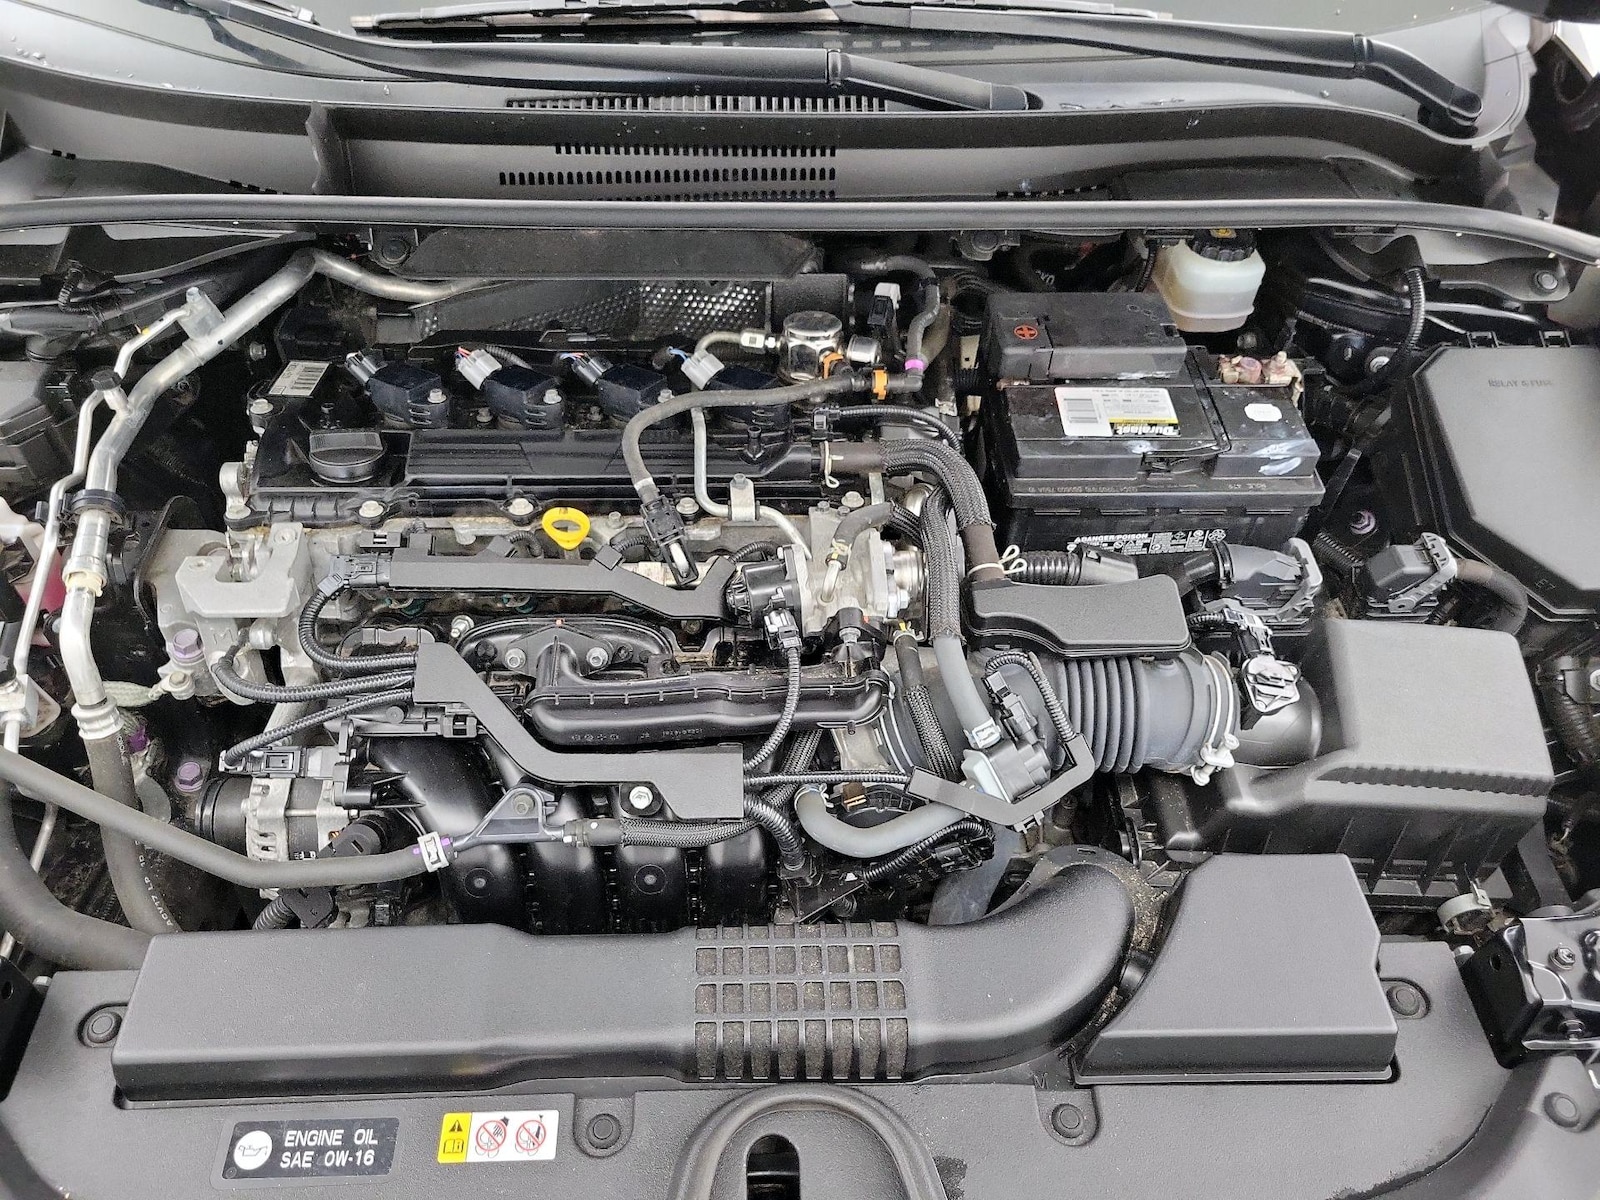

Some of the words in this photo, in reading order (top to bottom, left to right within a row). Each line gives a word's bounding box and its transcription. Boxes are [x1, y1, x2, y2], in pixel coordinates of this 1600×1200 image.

[1488, 379, 1518, 388] RELAY
[1116, 423, 1177, 436] Duralast
[284, 1129, 344, 1147] ENGINE
[353, 1128, 378, 1145] OIL
[279, 1151, 314, 1168] SAE
[324, 1149, 375, 1167] 0W-16
